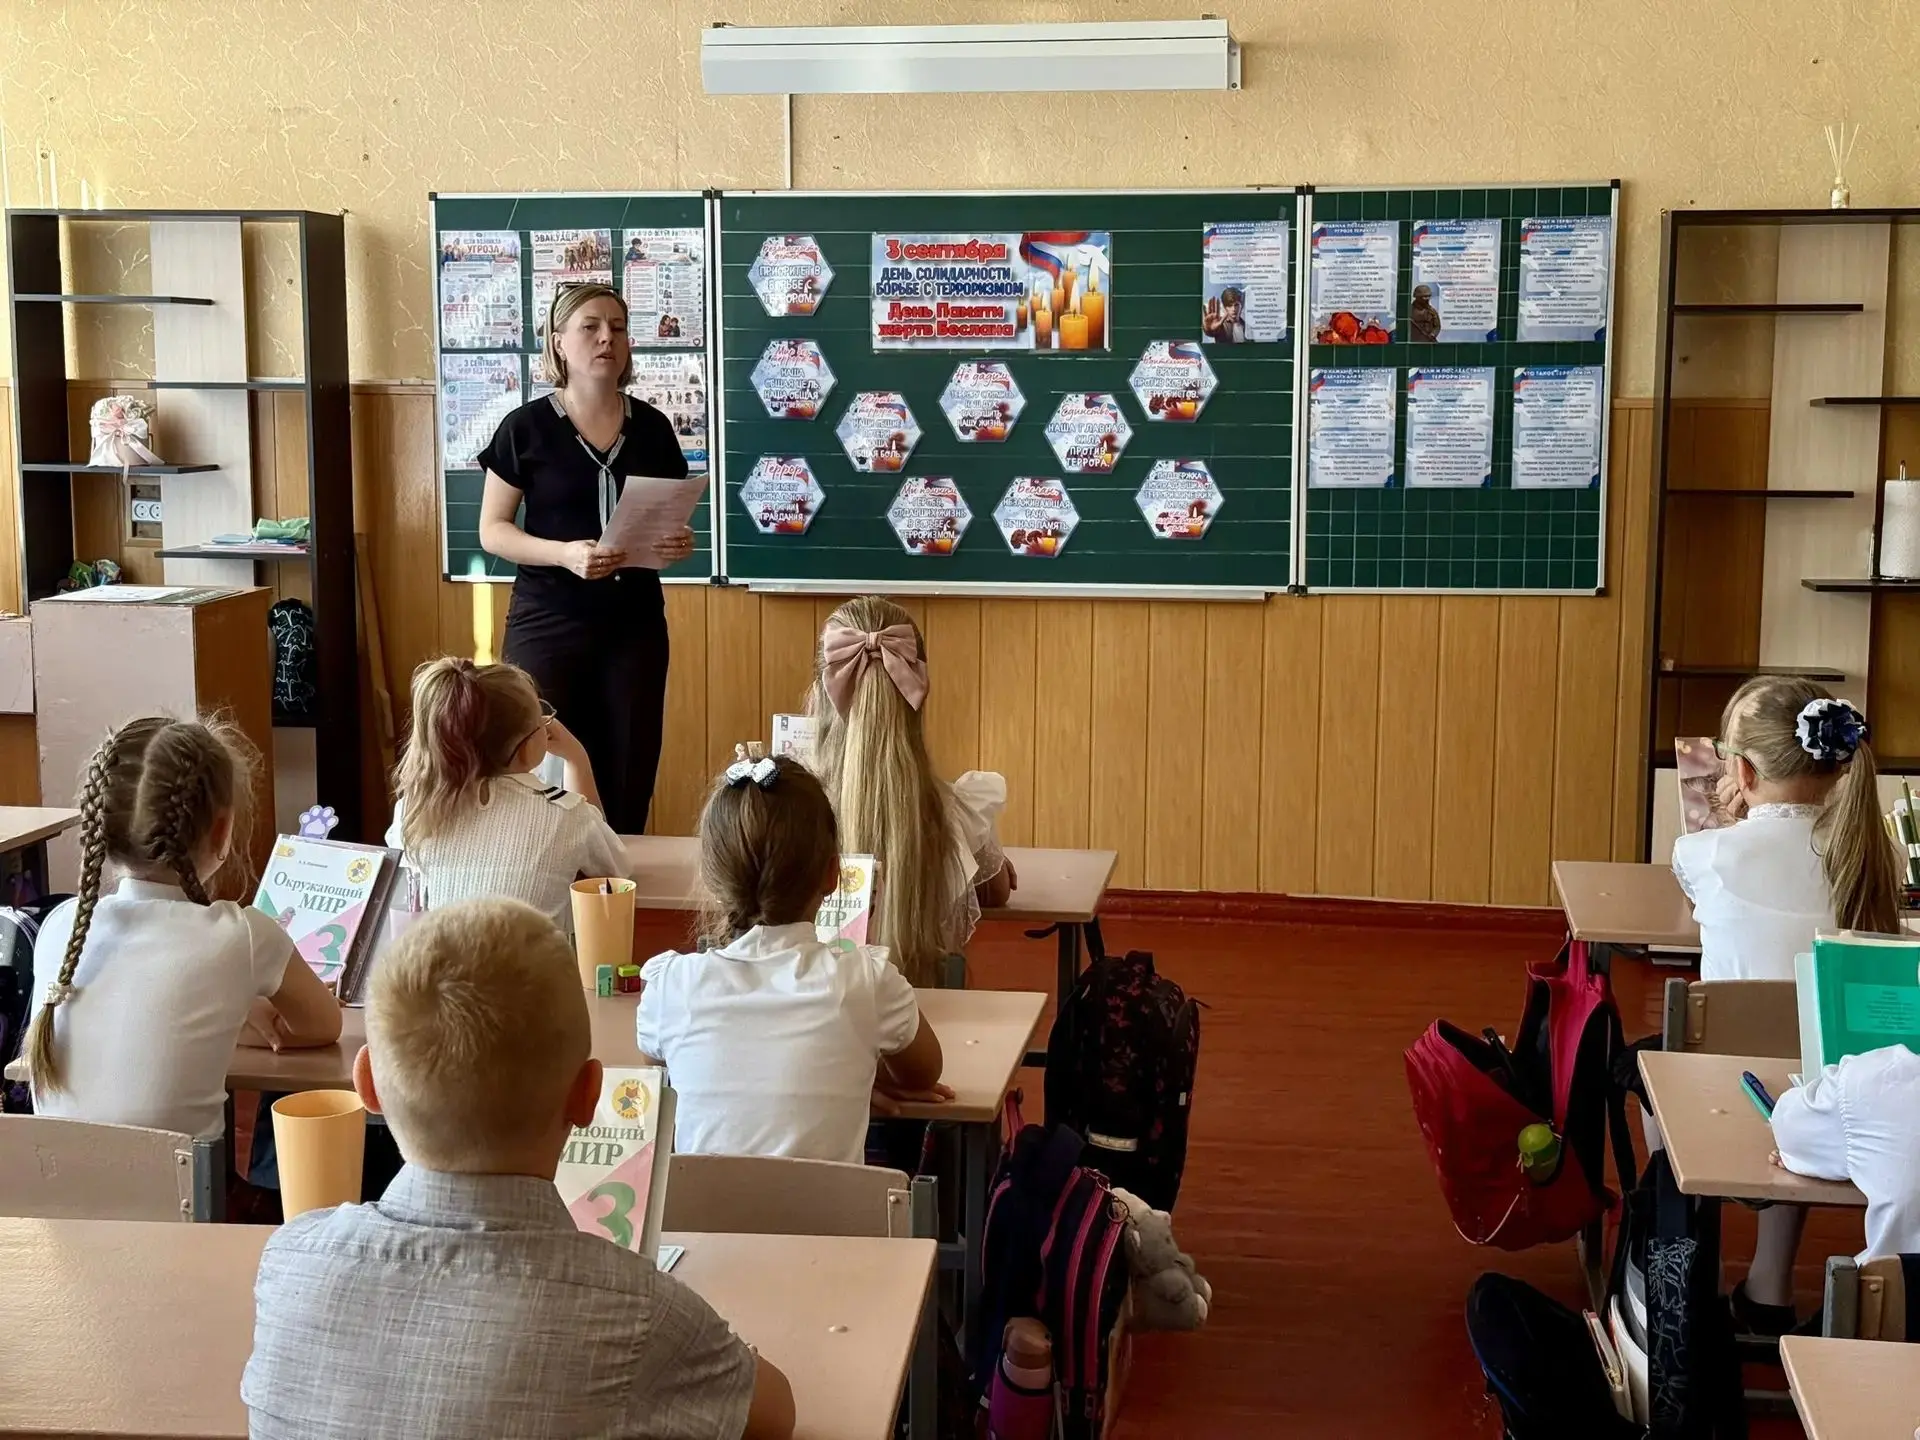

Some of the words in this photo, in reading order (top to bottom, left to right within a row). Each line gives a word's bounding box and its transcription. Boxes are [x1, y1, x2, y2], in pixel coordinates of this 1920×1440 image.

[468, 245, 499, 253] УГРОЗА
[886, 240, 901, 258] 3
[904, 239, 1006, 263] сентября
[759, 265, 813, 277] ПРИОРИТЕТ
[814, 265, 821, 276] В
[880, 267, 912, 281] ДЕНЬ
[916, 267, 1011, 281] СОЛИДАРНОСТИ
[876, 282, 919, 296] БОРЬБЕ
[923, 282, 931, 295] С
[935, 282, 1024, 296] ТЕРРОРИЗМОМ
[888, 303, 933, 320] День
[936, 302, 1004, 320] Памяти
[878, 321, 933, 339] жертв
[936, 321, 1014, 338] Беслана
[781, 368, 805, 377] НАША
[956, 369, 969, 380] Не
[971, 372, 1008, 387] дадим
[764, 379, 795, 388] ОБЩАЯ
[1134, 377, 1165, 387] ПРОТИВ
[764, 390, 787, 400] НАША
[789, 391, 819, 400] ОБЩАЯ
[1061, 402, 1109, 420] Единство
[1048, 423, 1075, 433] НАША
[1079, 423, 1126, 433] ГЛАВНАЯ
[1075, 435, 1101, 444] СИЛА
[1070, 446, 1106, 455] ПРОТИВ
[1066, 458, 1110, 467] ТЕРРОРА.
[763, 460, 802, 480] Террор
[938, 508, 967, 518] ЖИЗНЬ
[274, 872, 363, 899] Окружающий
[299, 893, 347, 914] МИР
[316, 924, 347, 977] 3
[587, 1181, 636, 1249] 3
